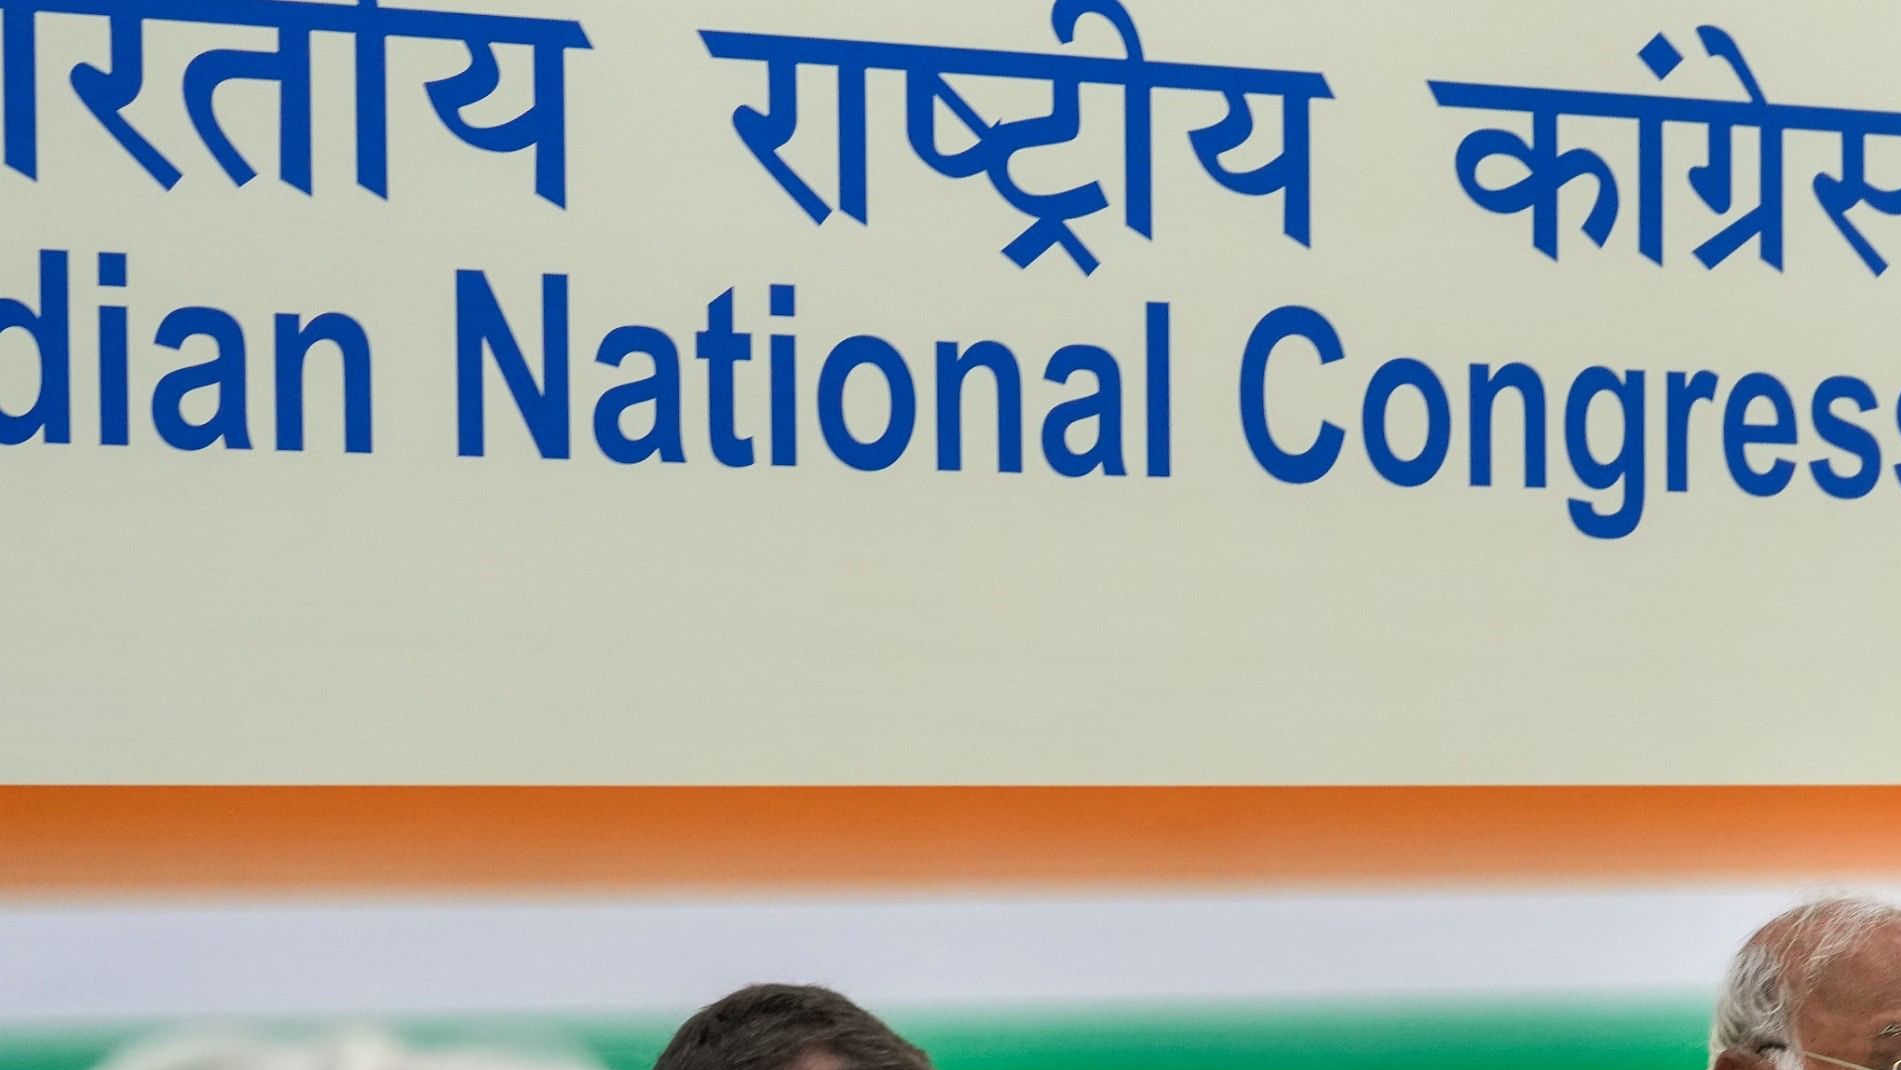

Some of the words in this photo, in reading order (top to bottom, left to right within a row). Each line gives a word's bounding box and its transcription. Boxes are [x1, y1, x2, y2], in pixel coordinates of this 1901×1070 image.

[0, 0, 592, 211] ारतीय
[698, 0, 1335, 277] राष्ट्रीय
[0, 248, 373, 454] dian
[455, 268, 1172, 478] National
